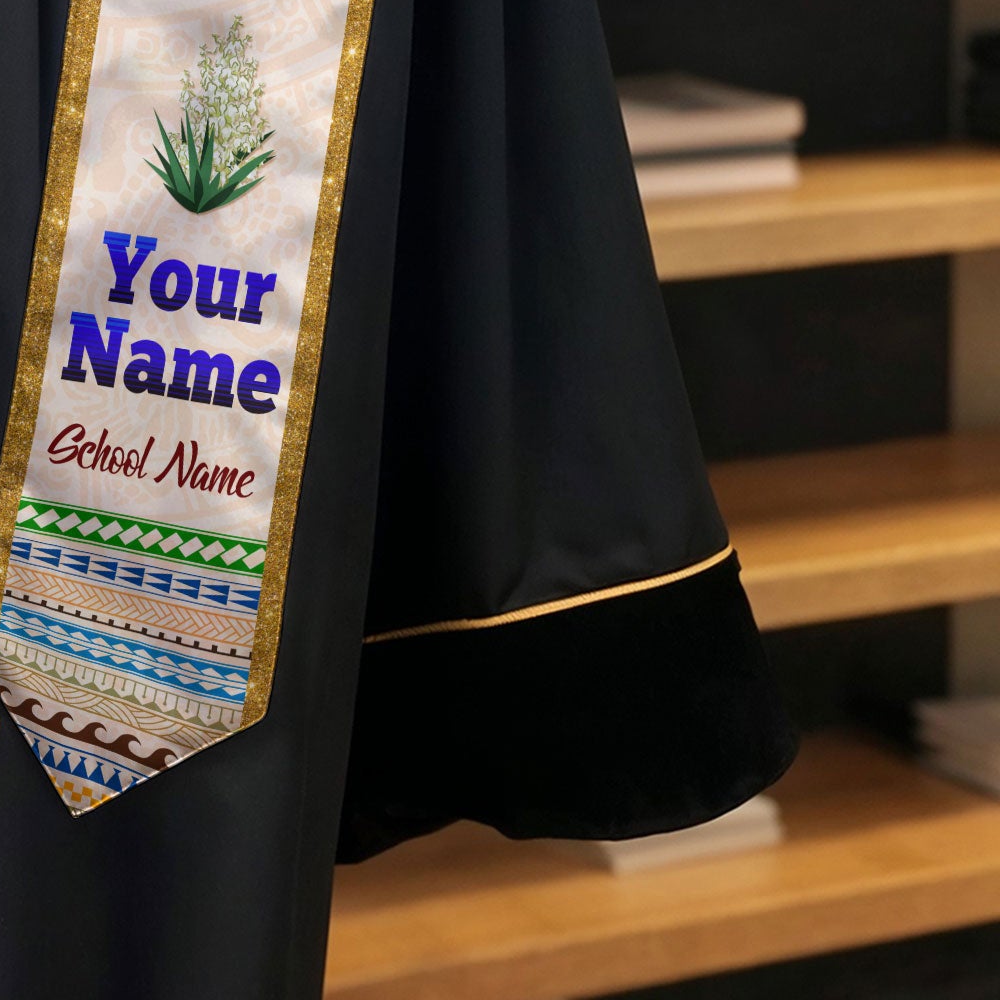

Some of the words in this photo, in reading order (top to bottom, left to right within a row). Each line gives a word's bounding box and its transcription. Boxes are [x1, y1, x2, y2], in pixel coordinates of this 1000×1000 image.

[103, 230, 277, 325] Your
[61, 311, 281, 415] Name
[47, 423, 155, 479] School
[154, 440, 256, 499] Name
